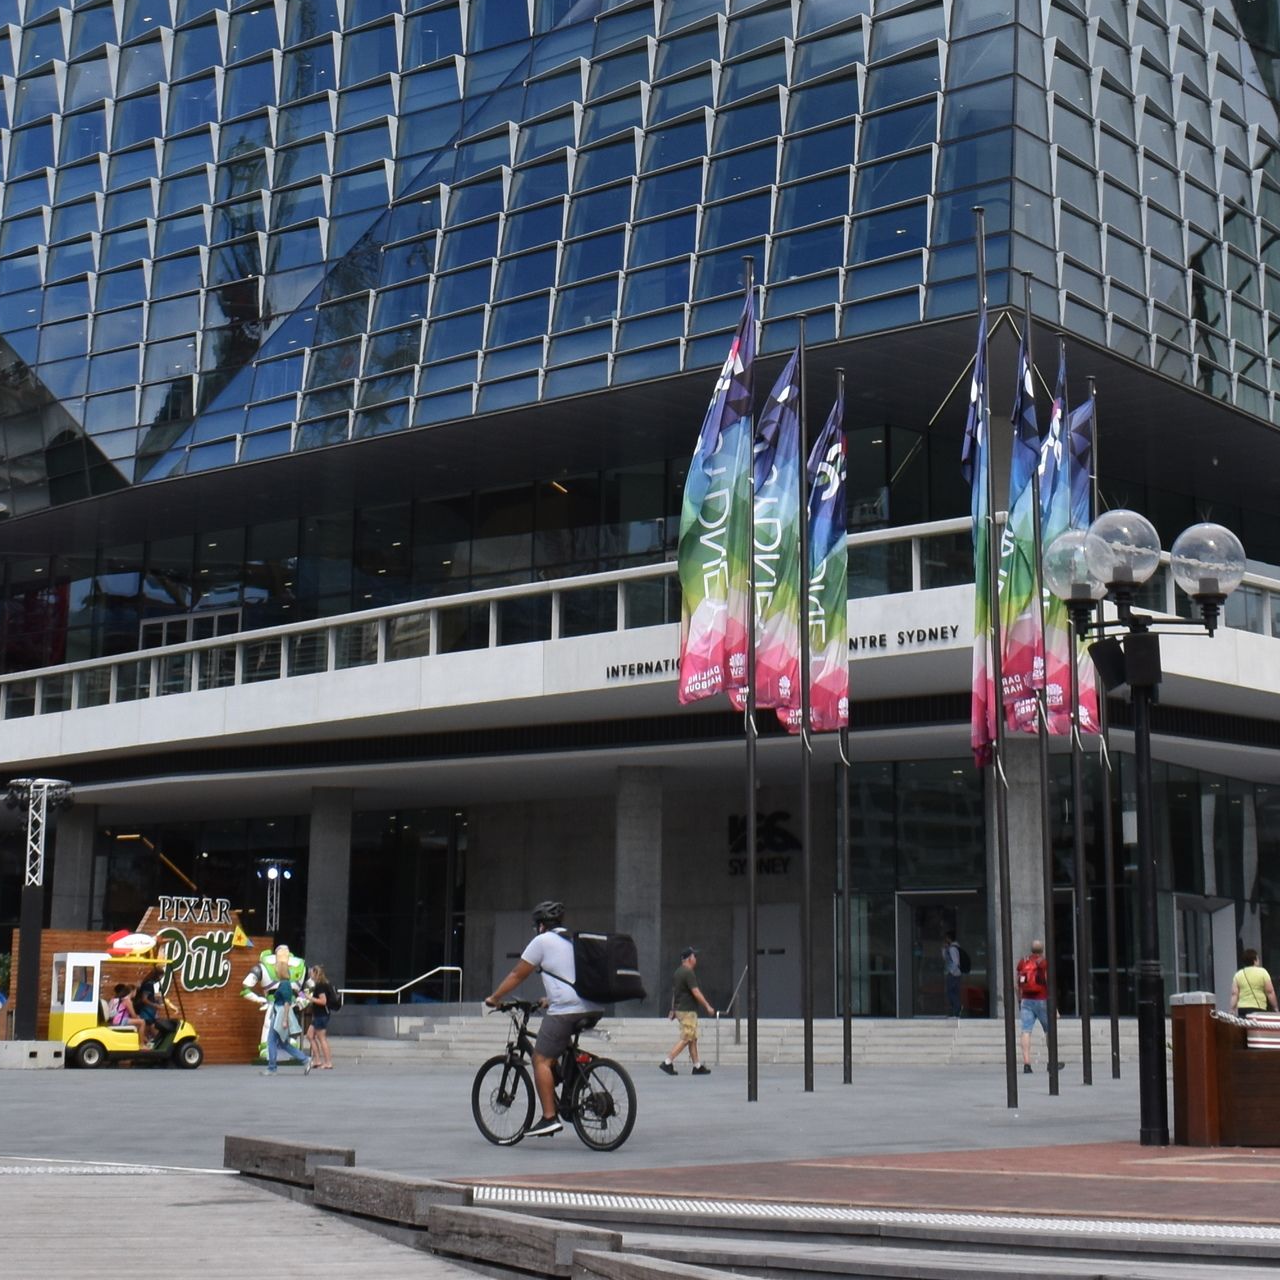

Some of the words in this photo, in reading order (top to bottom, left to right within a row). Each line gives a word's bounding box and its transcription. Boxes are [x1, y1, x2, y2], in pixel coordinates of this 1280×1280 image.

[606, 657, 681, 679] INTERNATI
[848, 634, 887, 651] NTRE
[897, 624, 959, 646] SYDNEY
[728, 856, 791, 876] SYNEY
[157, 895, 232, 925] PIXAR
[156, 926, 234, 997] Putt
